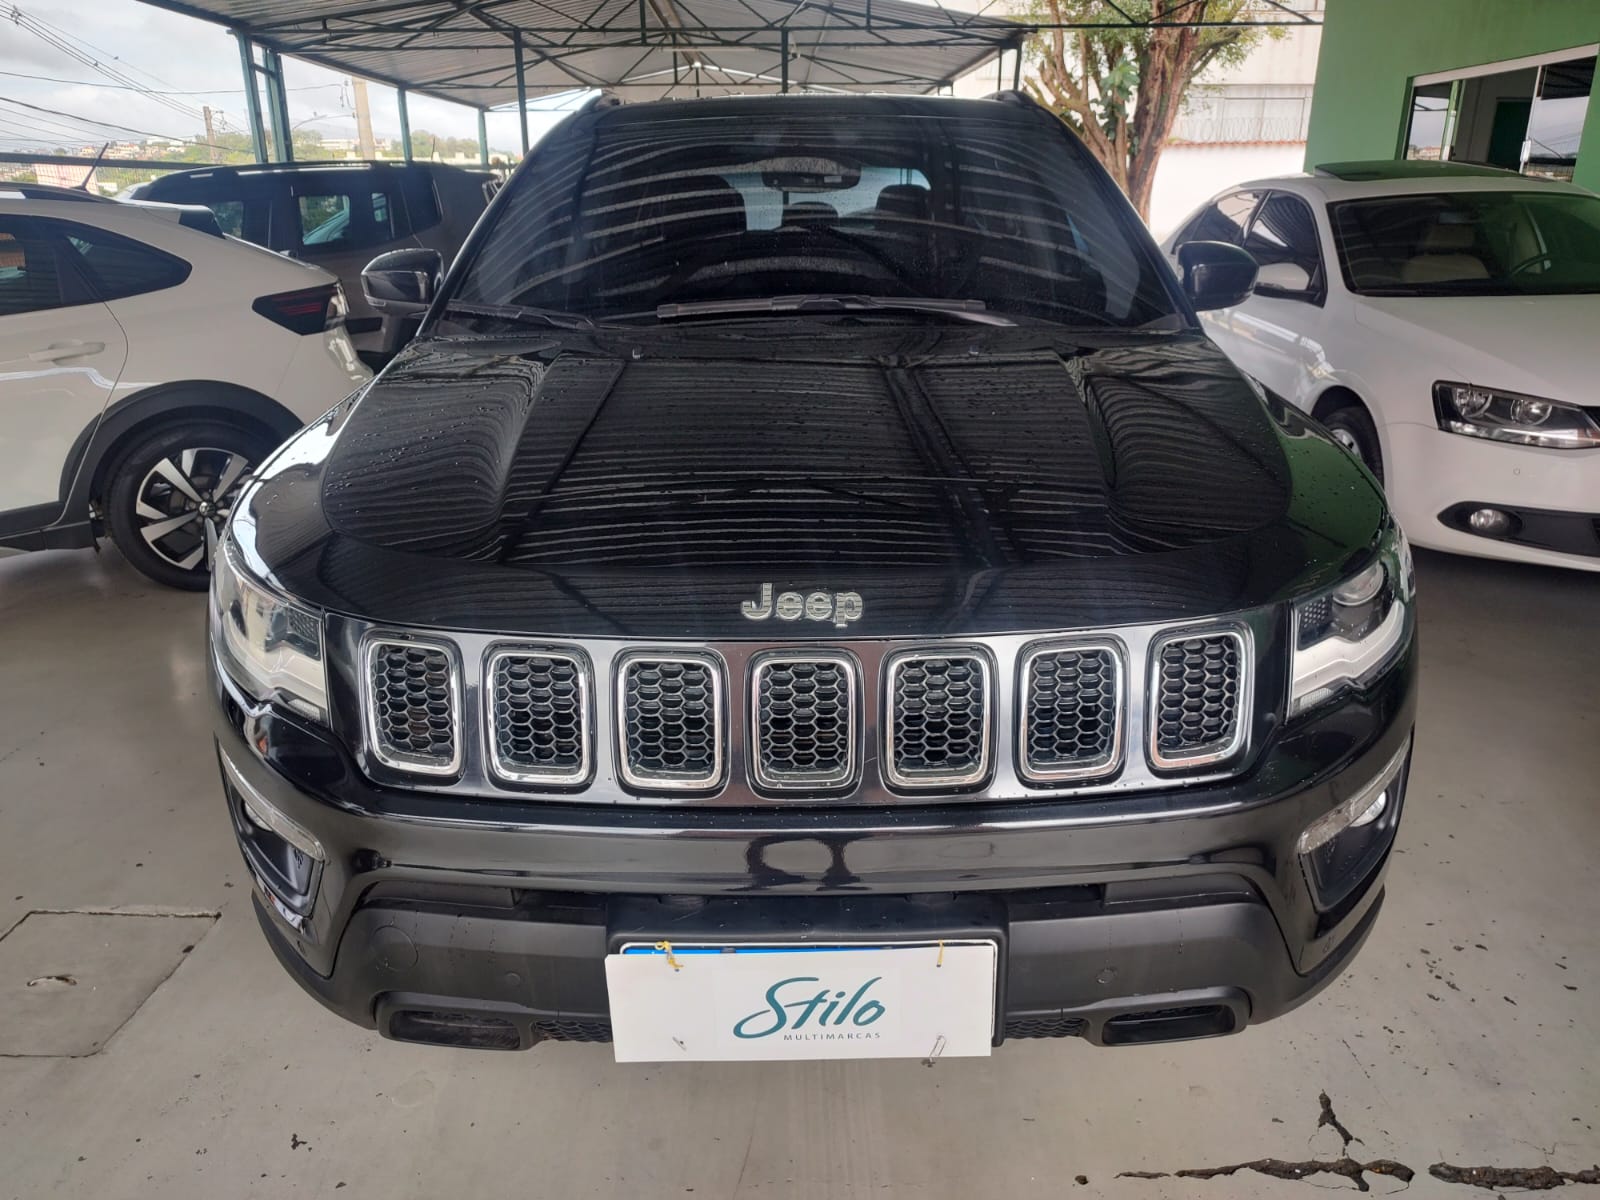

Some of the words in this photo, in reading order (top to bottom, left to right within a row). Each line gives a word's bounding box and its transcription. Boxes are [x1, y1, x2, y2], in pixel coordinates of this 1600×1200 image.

[741, 583, 863, 628] Jeep
[733, 977, 885, 1039] Stilo
[783, 1032, 880, 1041] MULTIMARCAS
